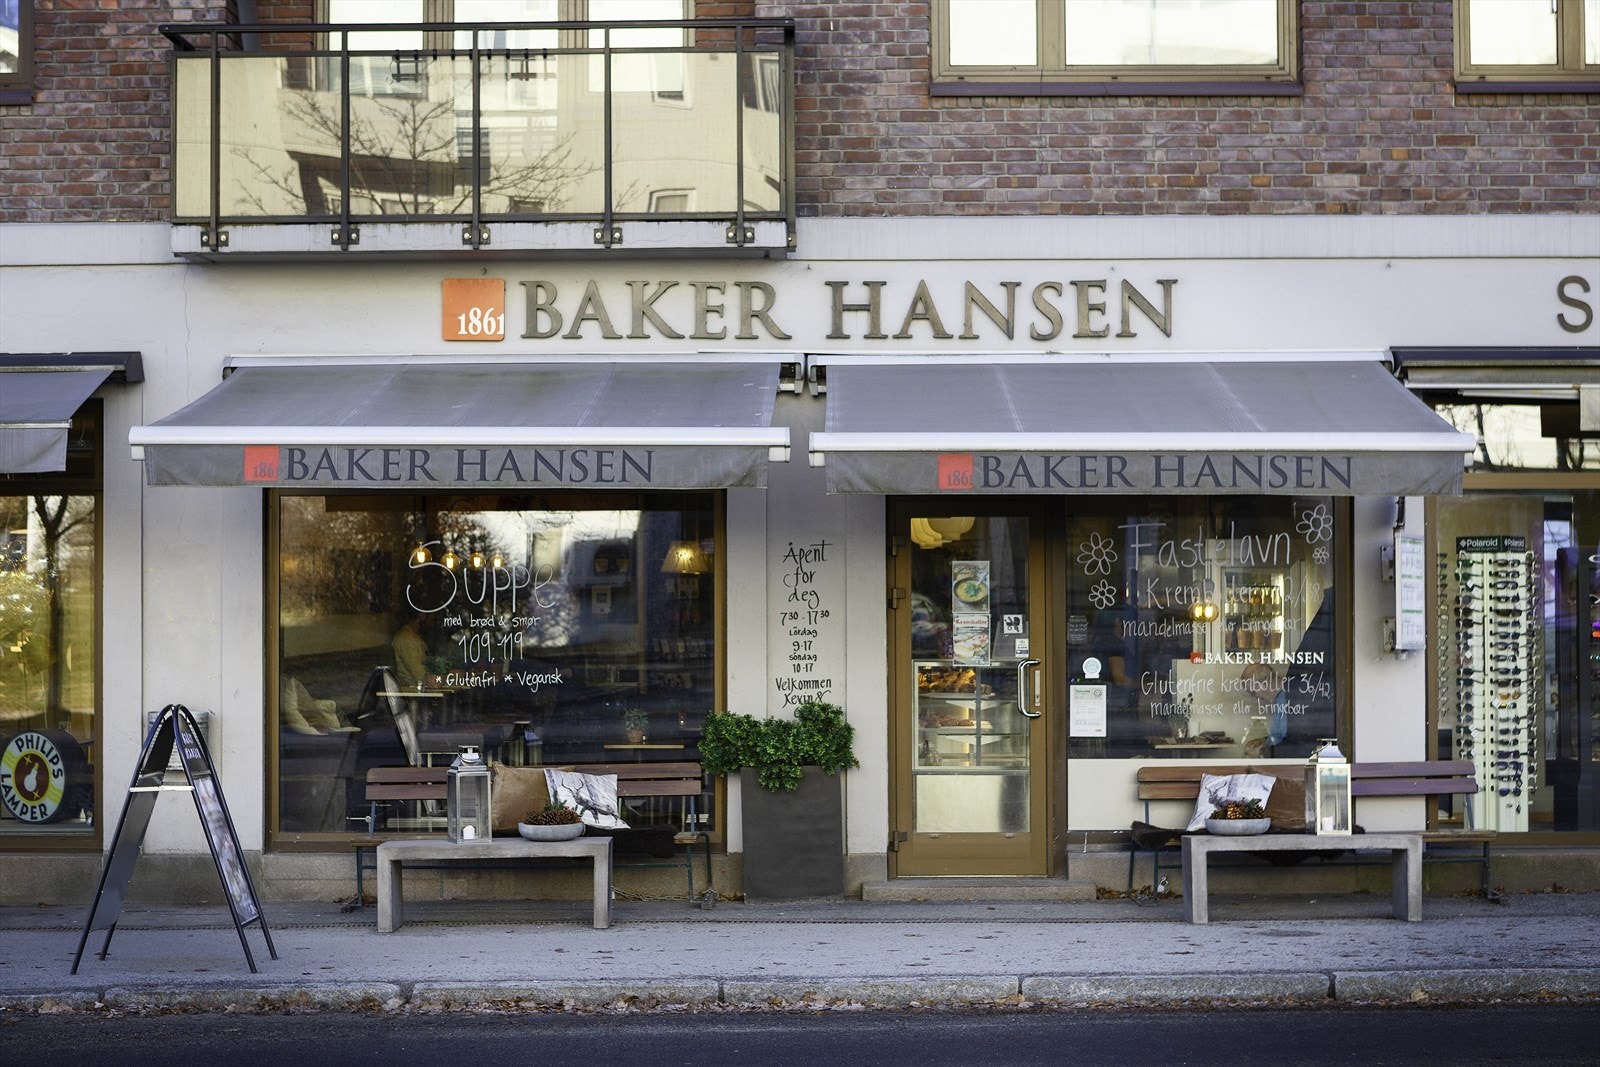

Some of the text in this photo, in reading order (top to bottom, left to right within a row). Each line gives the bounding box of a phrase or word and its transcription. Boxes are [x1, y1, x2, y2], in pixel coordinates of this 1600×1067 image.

[457, 279, 1179, 342] 1861 BAKER HANSEN
[1557, 275, 1593, 334] S
[284, 447, 439, 482] BAKER
[453, 448, 656, 483] HANSEN
[979, 454, 1138, 489] BAKER
[1151, 454, 1354, 489] HANSEN
[782, 539, 833, 572] Åpent
[1118, 520, 1291, 572] Fastelavn
[1466, 537, 1498, 548] Polaroid
[406, 540, 556, 615] Suppe
[783, 567, 817, 588] for
[788, 588, 820, 610] deg
[443, 613, 541, 629] med brød & smør
[1204, 651, 1255, 665] BAKER
[1259, 651, 1325, 665] HANSEN
[446, 667, 564, 693] Glutenfri Vegansk
[775, 677, 832, 694] Velkommen
[1141, 669, 1215, 696] Glutenfrie
[1221, 669, 1296, 693] kremboller
[15, 734, 64, 779] PHILIPS
[0, 773, 49, 820] LAMPER
